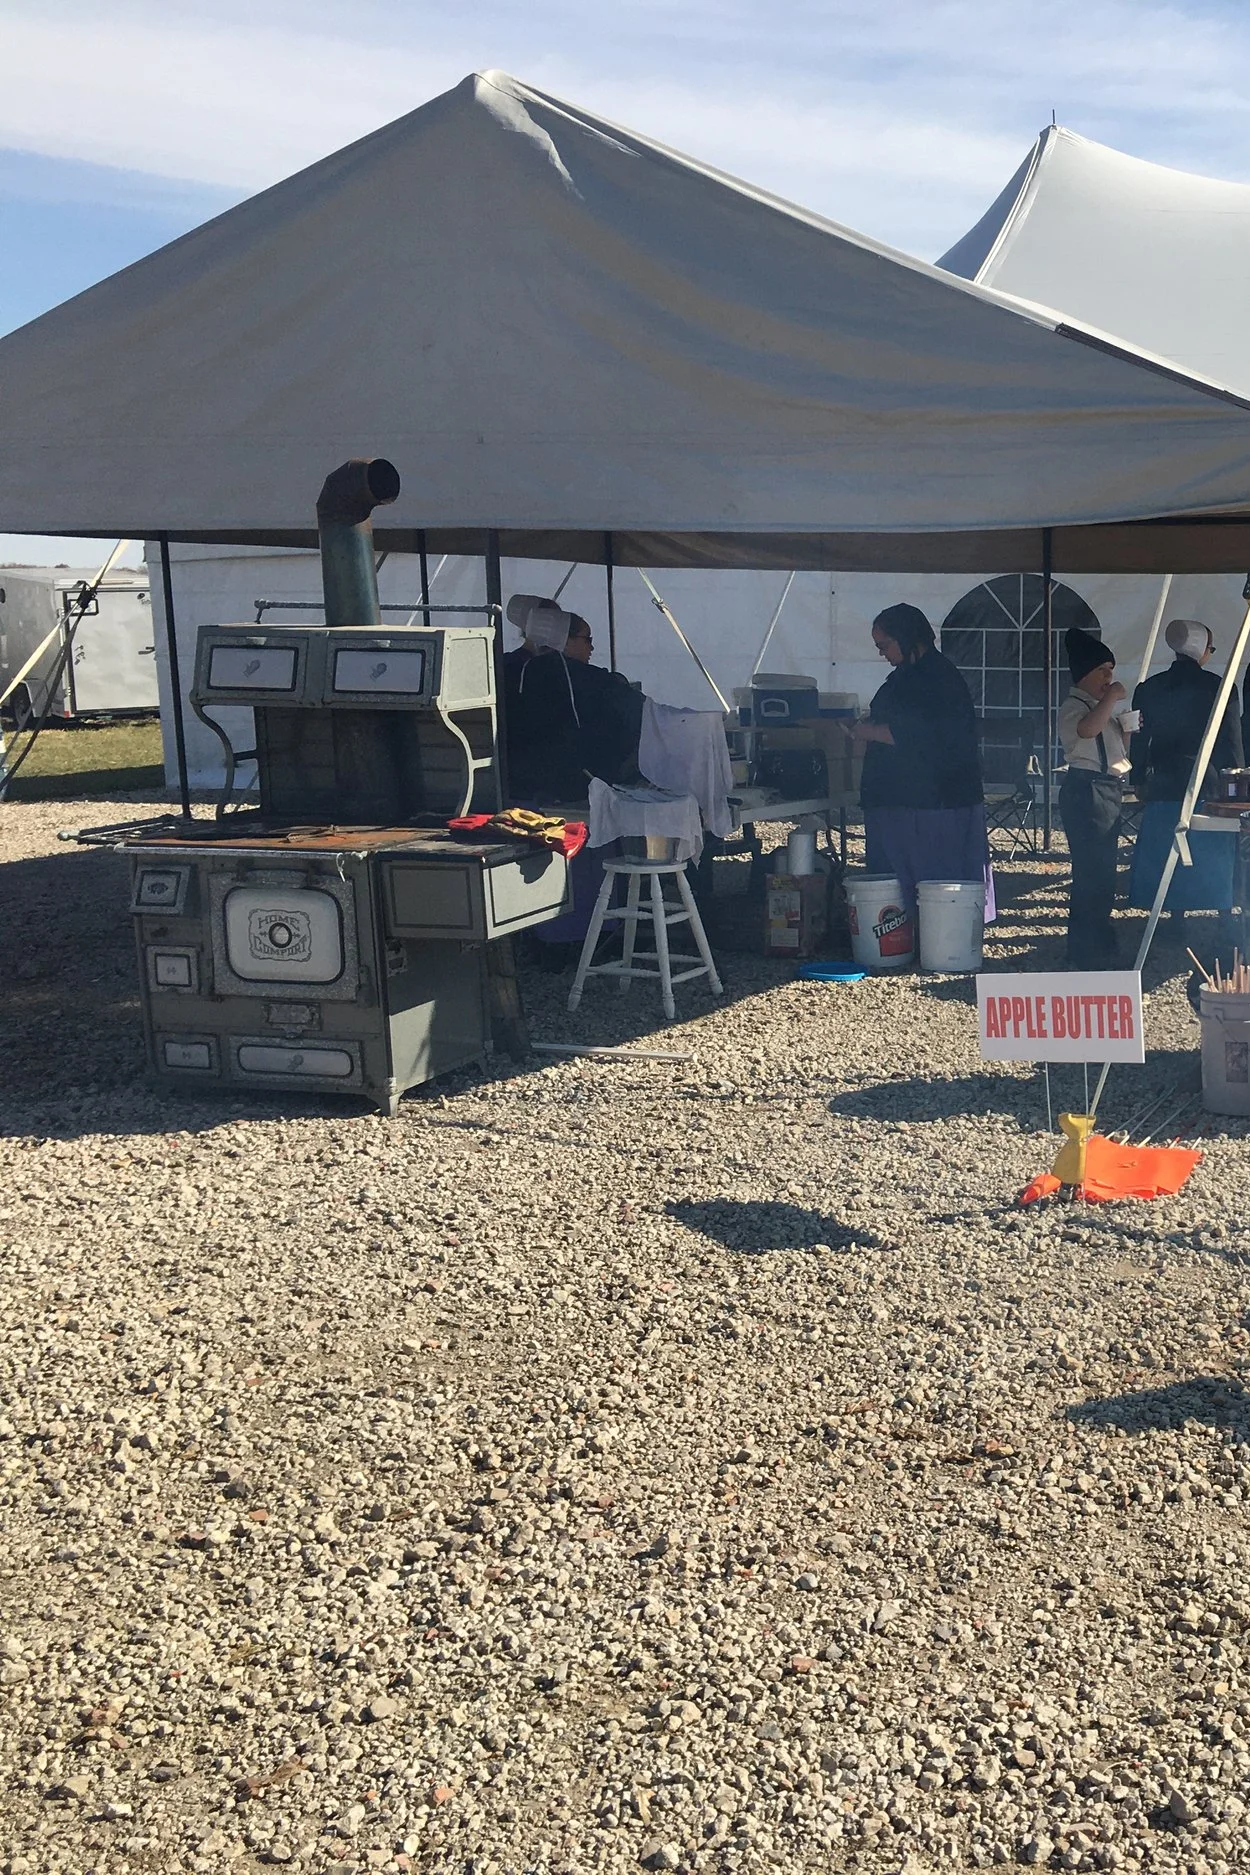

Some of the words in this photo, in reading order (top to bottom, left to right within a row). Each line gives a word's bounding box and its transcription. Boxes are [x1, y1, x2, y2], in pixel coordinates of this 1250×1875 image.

[257, 914, 300, 931] HOME
[873, 914, 906, 937] Titebo
[986, 996, 1048, 1039] APPLE
[1051, 995, 1134, 1040] BUTTER
